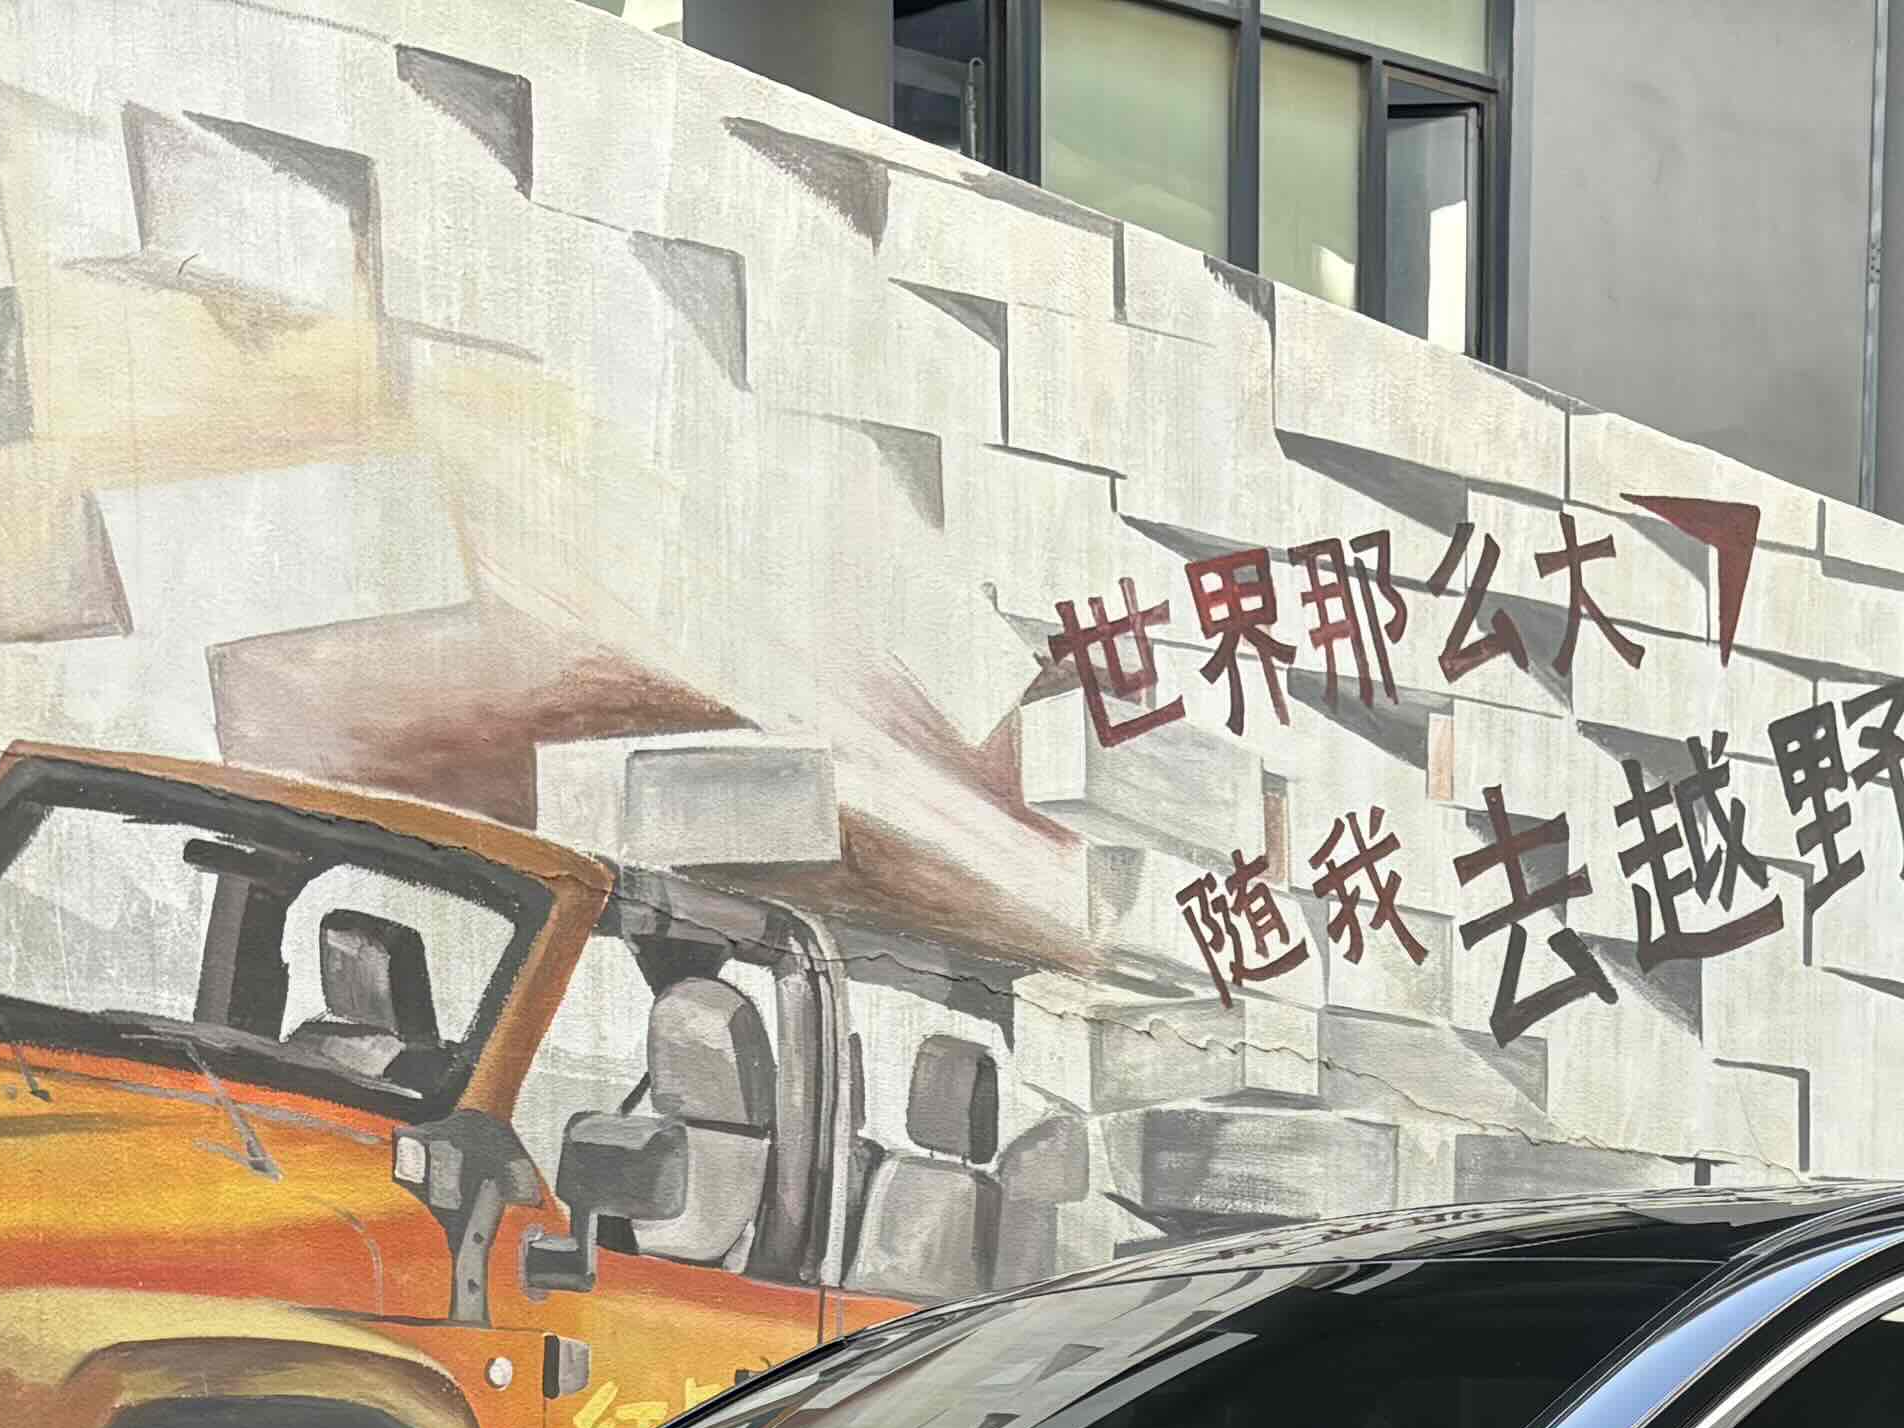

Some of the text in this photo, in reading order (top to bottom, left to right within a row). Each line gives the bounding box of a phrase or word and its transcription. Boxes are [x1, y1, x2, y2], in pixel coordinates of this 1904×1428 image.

[1046, 511, 1646, 748] 世界那么大
